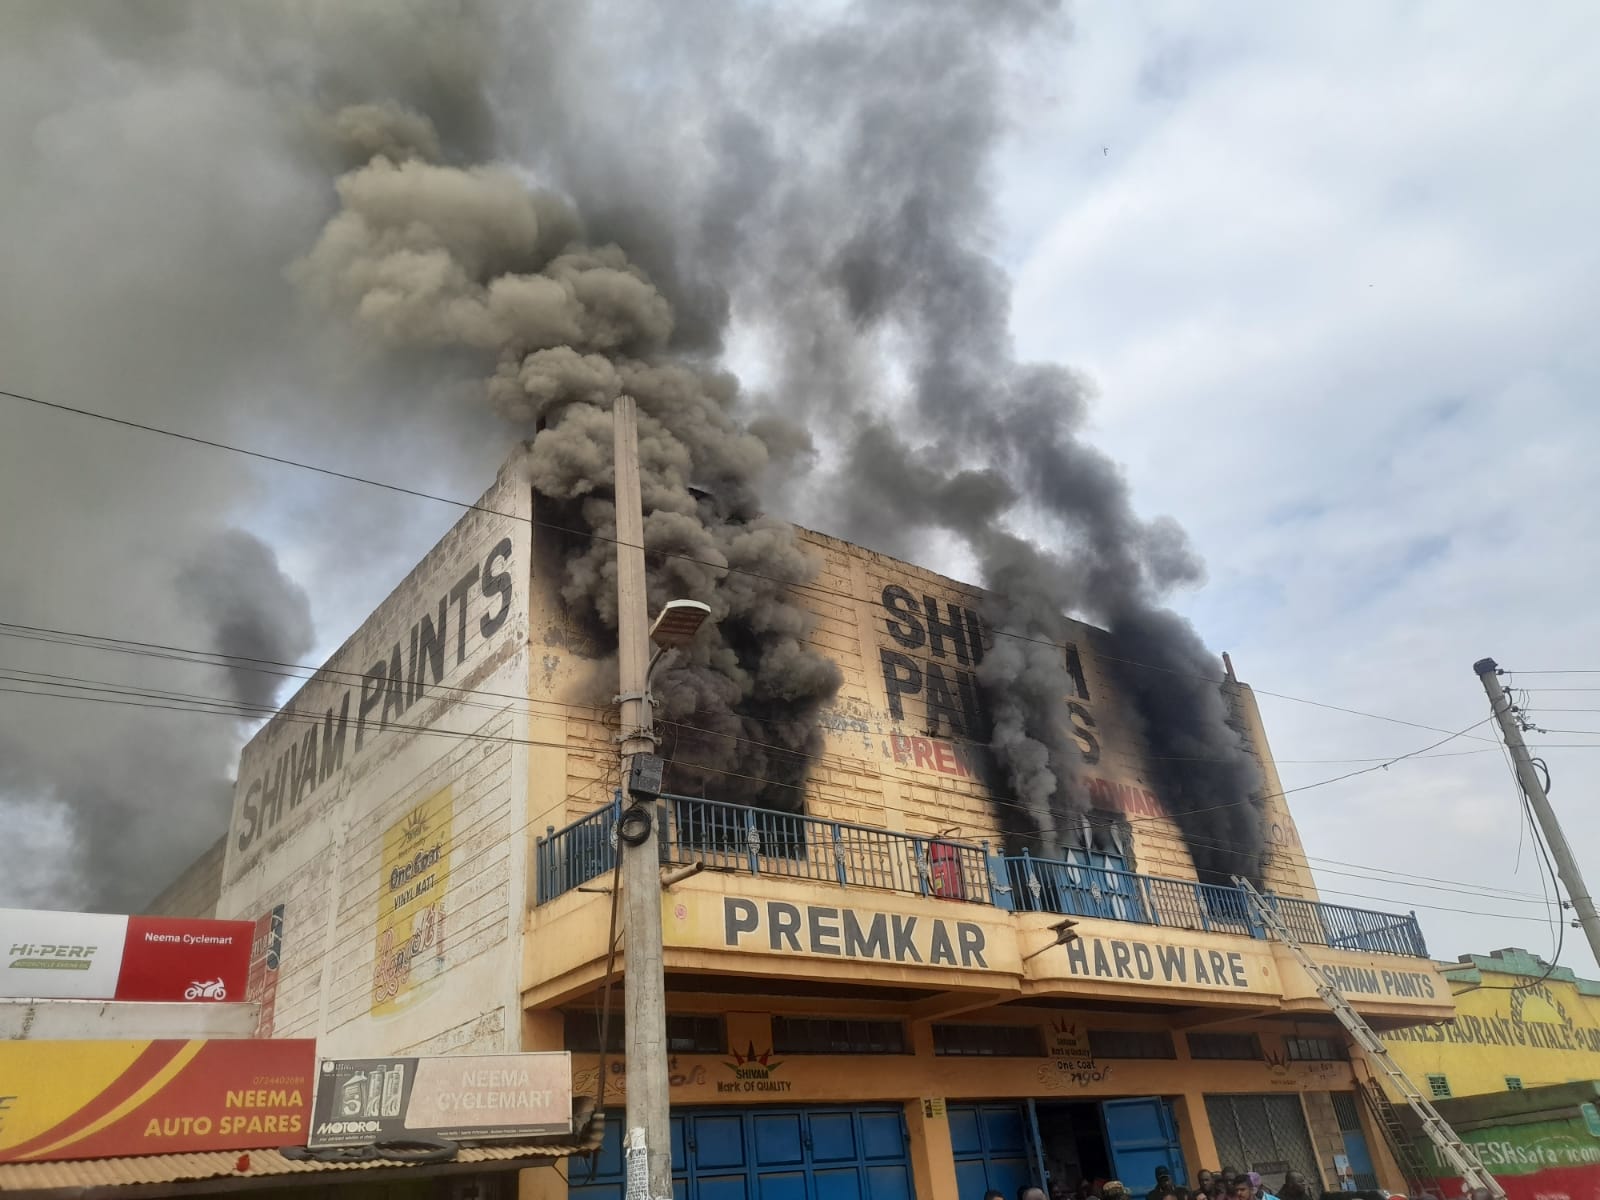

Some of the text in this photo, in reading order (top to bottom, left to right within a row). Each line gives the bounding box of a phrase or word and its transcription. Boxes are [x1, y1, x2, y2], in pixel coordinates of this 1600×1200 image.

[239, 537, 512, 851] SHIVAM PAINTS
[415, 874, 436, 896] MATT
[145, 932, 233, 945] Neema Cyclemart
[724, 896, 1435, 998] PREMKAR HARDWARE SHIVAM PAINTS
[9, 944, 98, 958] Hi-PERF
[736, 1068, 769, 1079] SHIVAM
[1057, 1059, 1096, 1070] One Coat
[462, 1069, 529, 1089] NEEMA
[756, 1080, 792, 1092] QUALITY
[225, 1090, 304, 1108] NEEMA
[438, 1090, 552, 1111] CYCLEMART
[144, 1115, 302, 1137] AUTO SPARES
[317, 1120, 383, 1135] MOTOROL
